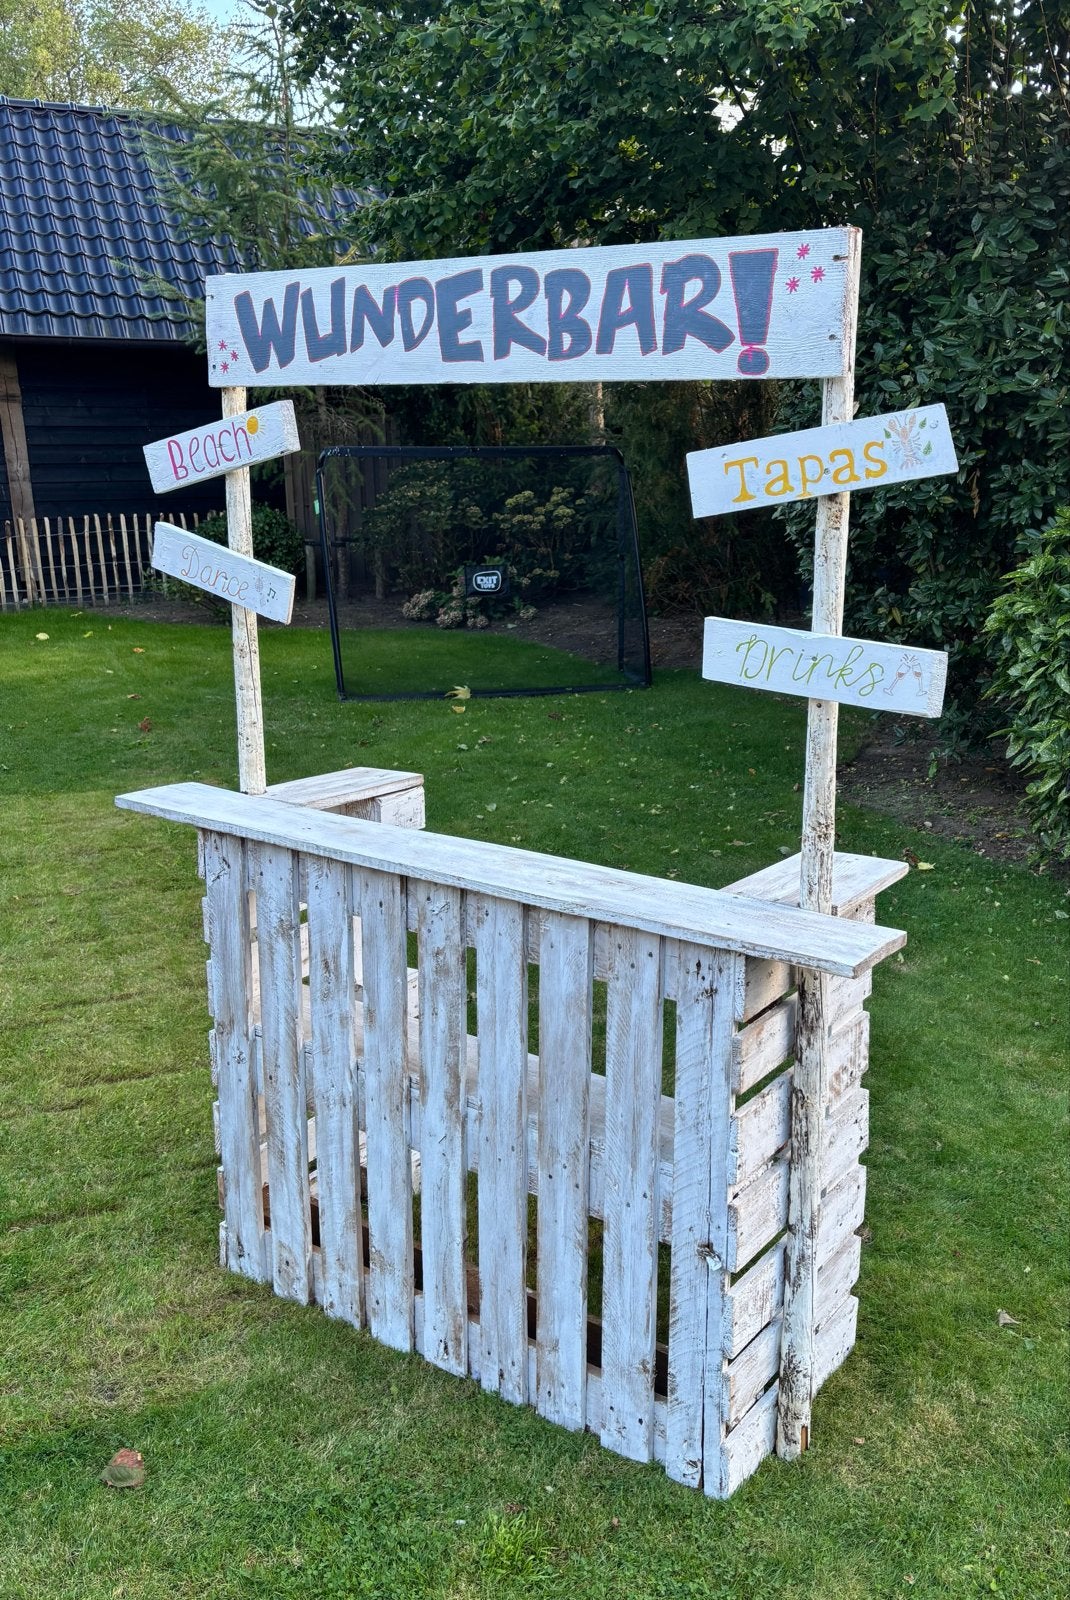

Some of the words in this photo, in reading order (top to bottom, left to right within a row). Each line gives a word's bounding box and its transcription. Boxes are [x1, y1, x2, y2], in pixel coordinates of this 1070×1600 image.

[234, 248, 779, 376] WUNDERBAR!
[167, 422, 252, 480] Beach
[724, 440, 888, 503] Tapas
[180, 545, 249, 601] Dance
[476, 575, 498, 584] EXIT
[736, 634, 884, 697] Drinks
